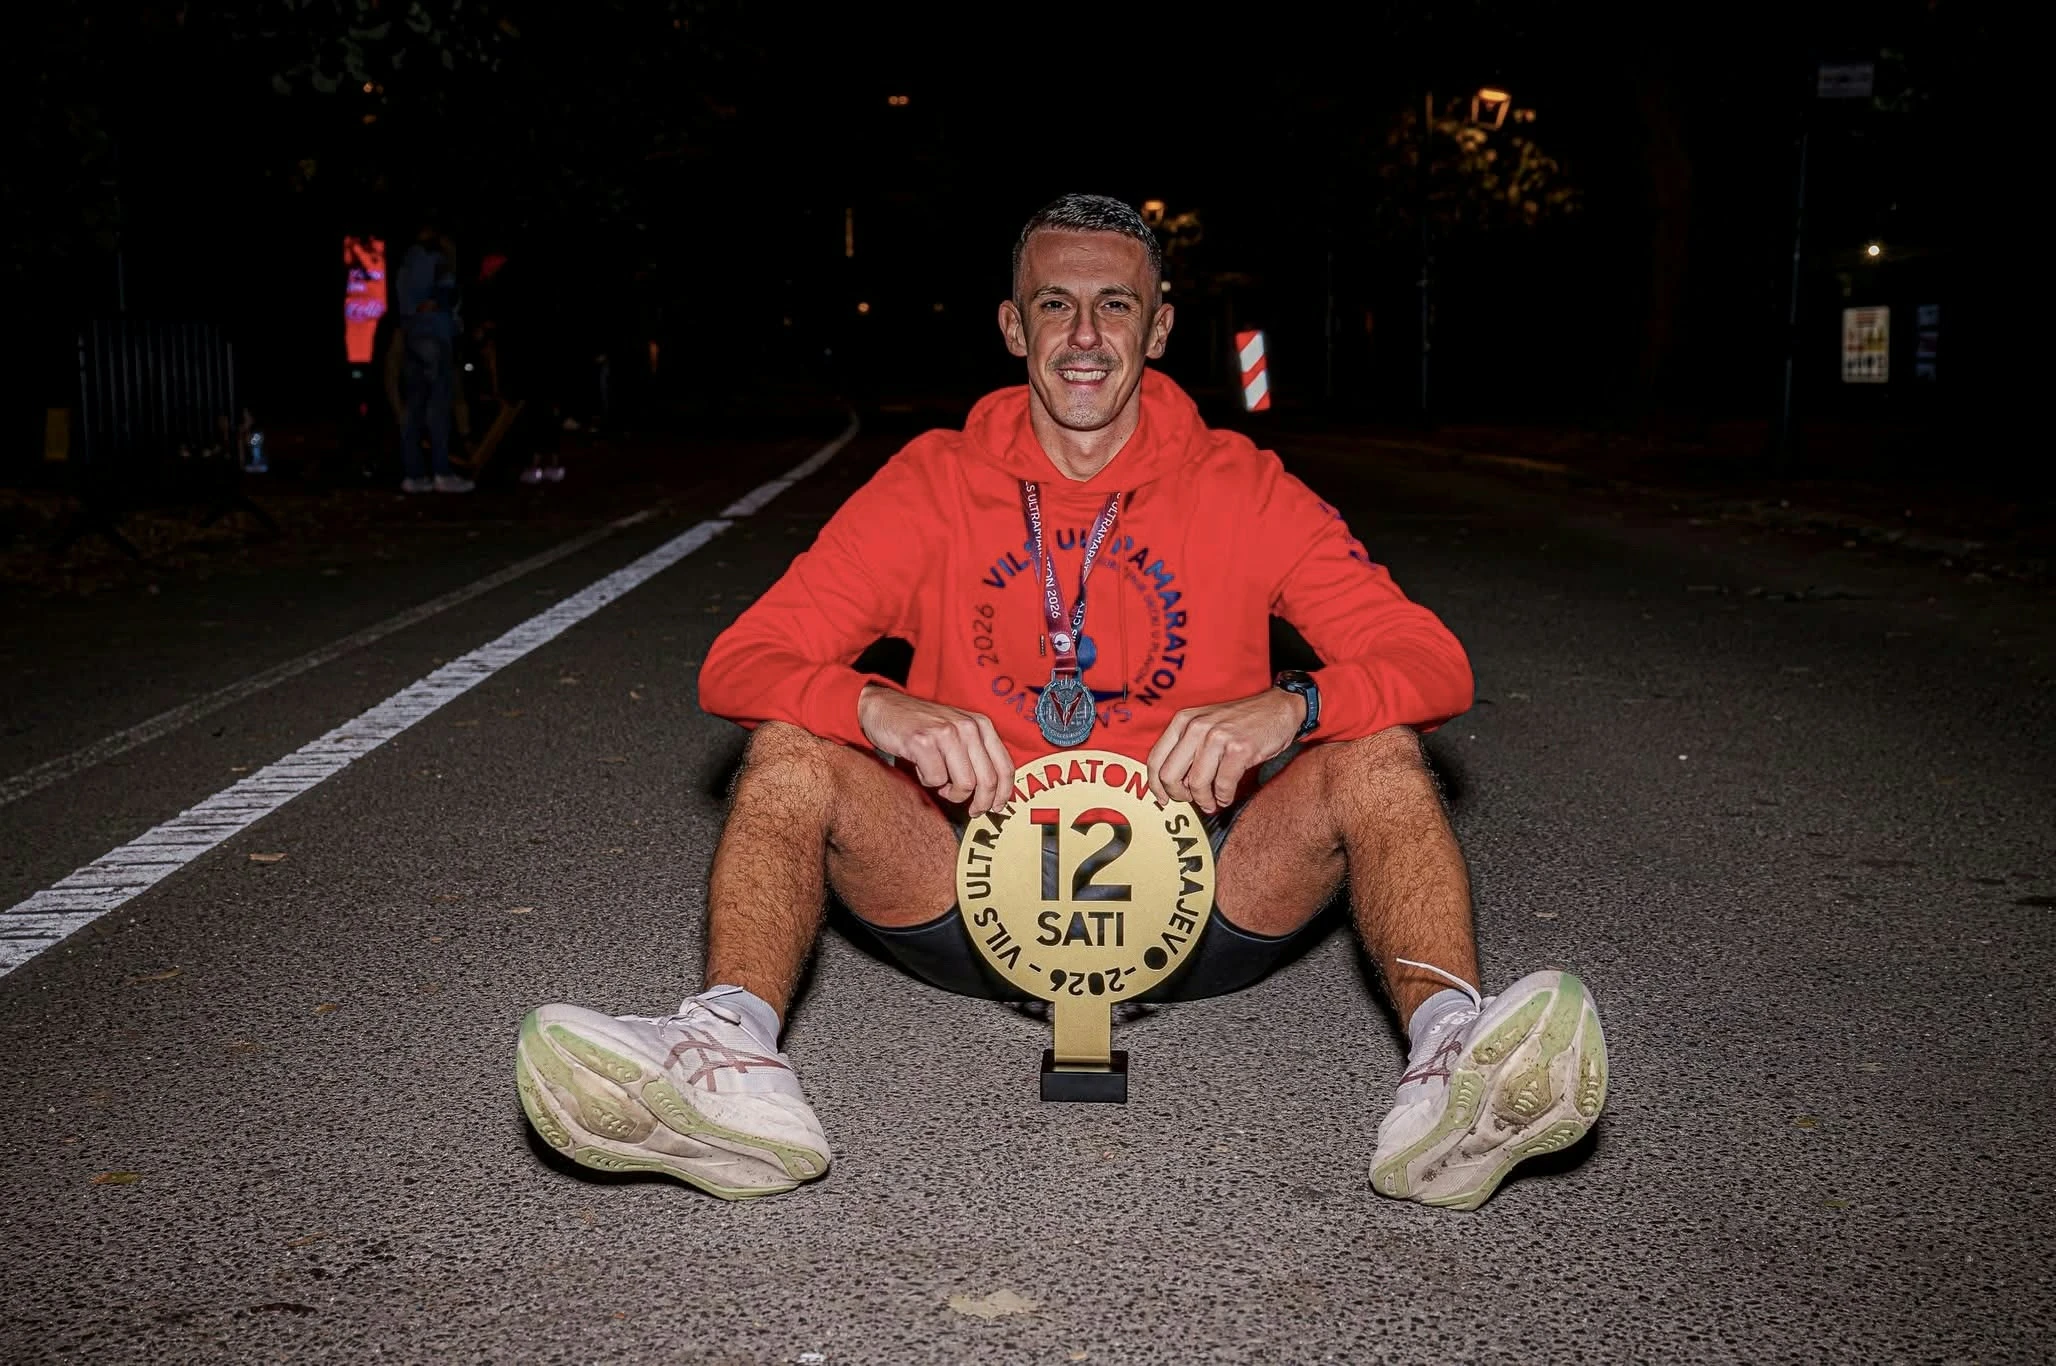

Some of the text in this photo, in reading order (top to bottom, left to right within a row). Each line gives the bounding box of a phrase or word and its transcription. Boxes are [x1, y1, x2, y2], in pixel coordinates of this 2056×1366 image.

[982, 540, 1033, 589] VIL
[1047, 590, 1062, 619] 2026
[1073, 601, 1085, 626] CITY
[974, 603, 999, 667] 2026
[1029, 807, 1133, 902] 12
[973, 906, 1021, 971] VILS
[1144, 814, 1204, 971] SARAJEVO
[1036, 910, 1124, 947] SATI
